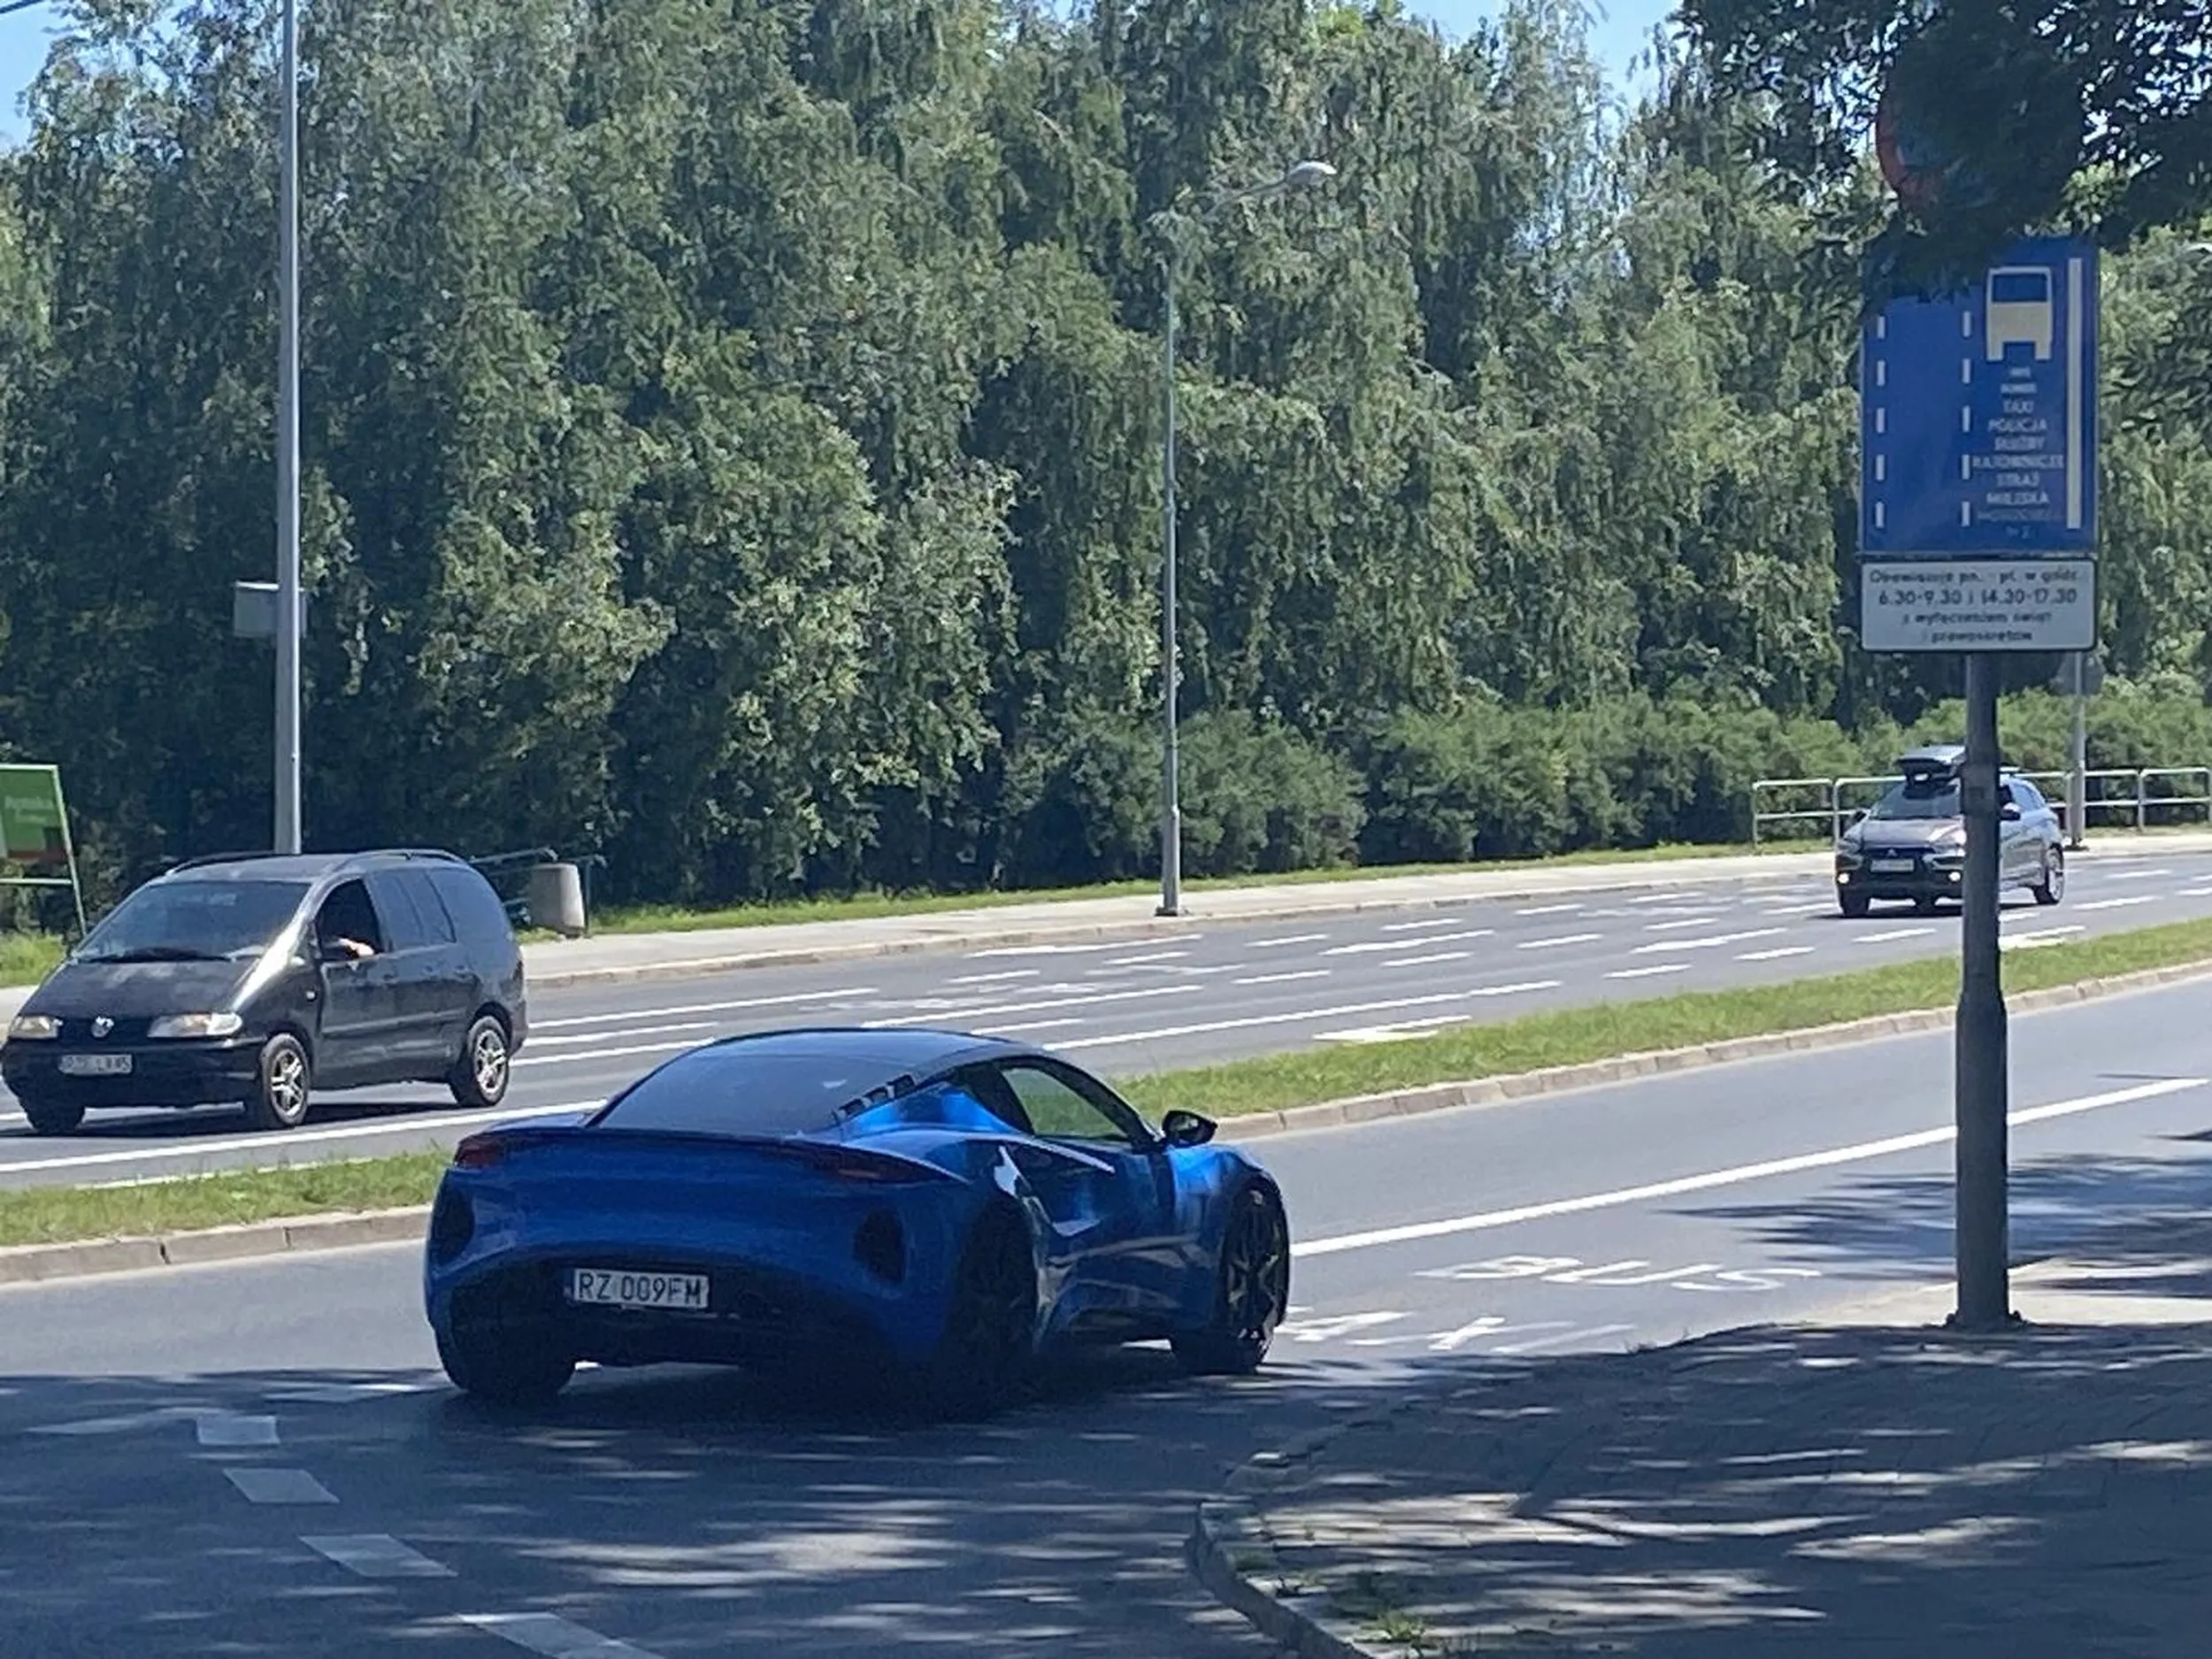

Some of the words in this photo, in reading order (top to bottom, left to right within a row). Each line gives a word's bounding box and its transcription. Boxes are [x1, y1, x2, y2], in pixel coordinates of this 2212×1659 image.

[1988, 419, 2047, 433] POLICJA
[1879, 589, 1962, 605] 6.30-9.30
[578, 1271, 611, 1300] RZ
